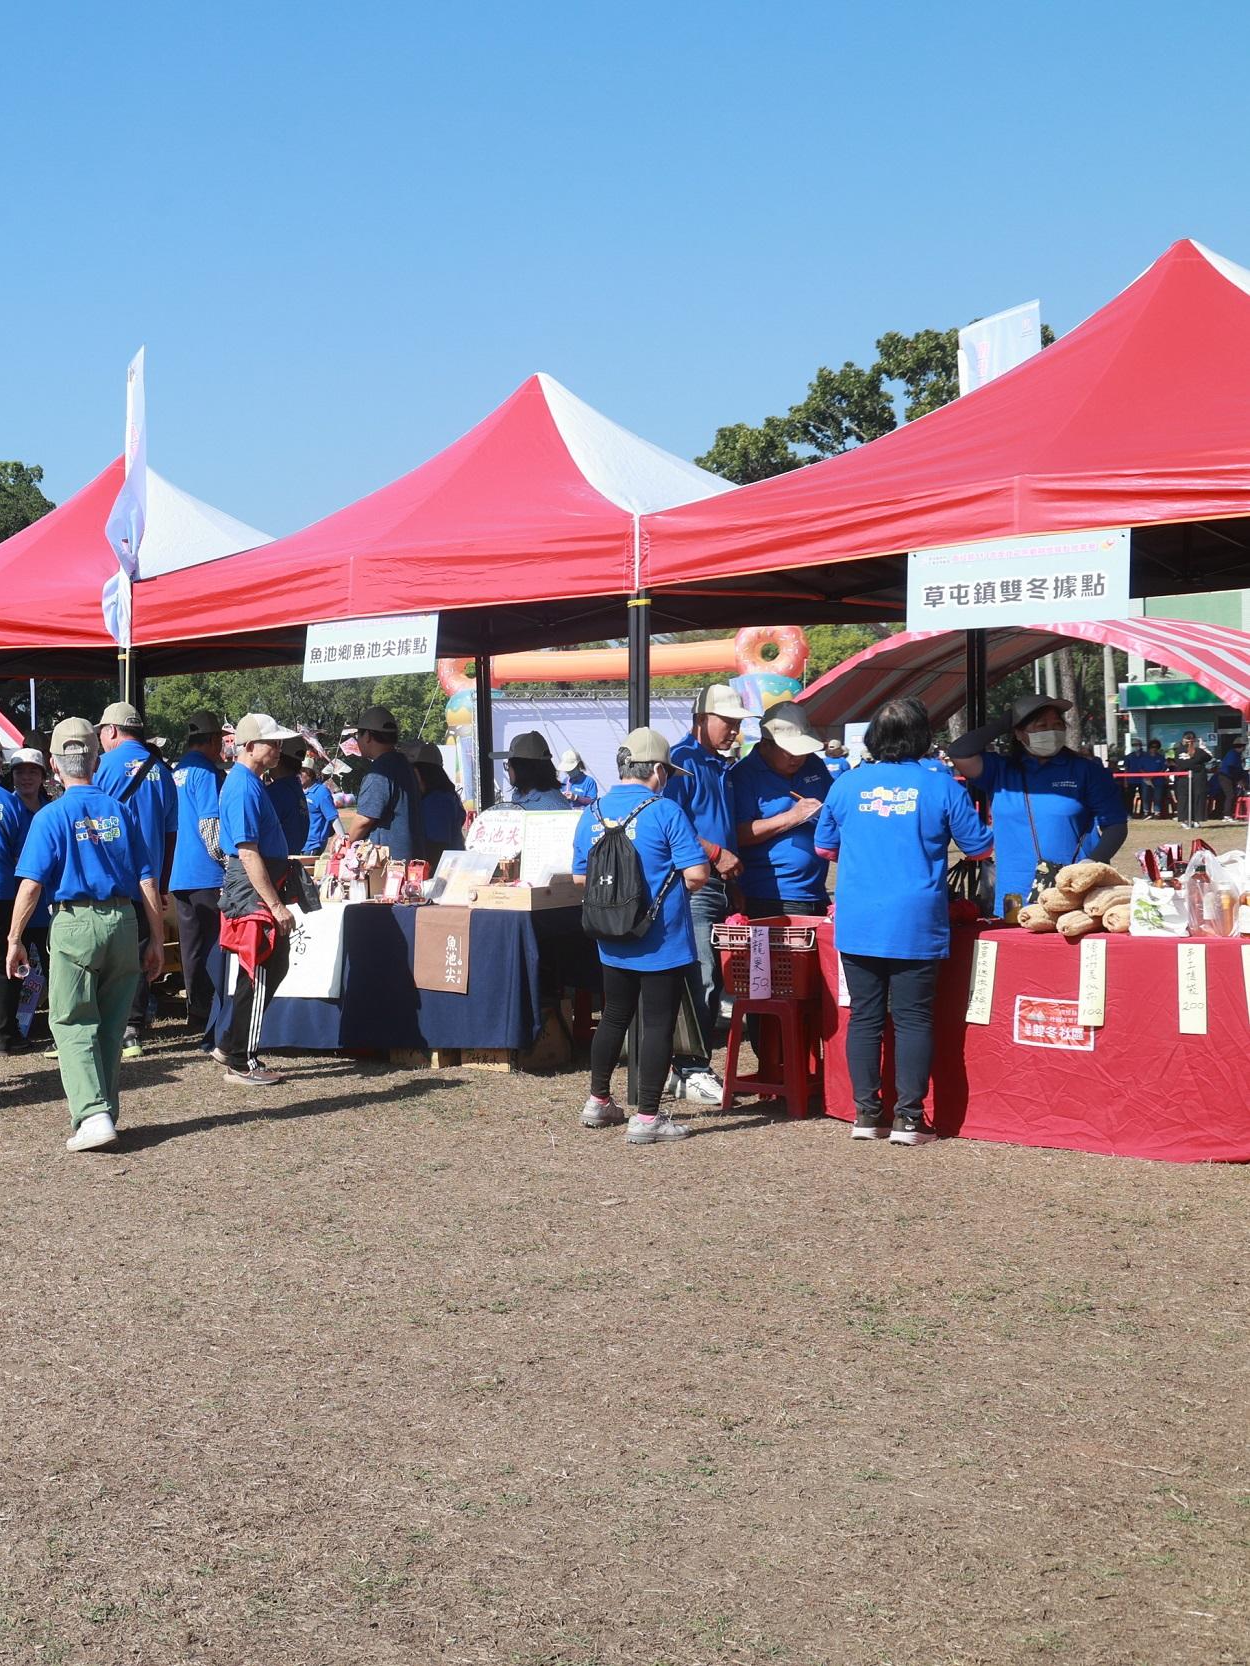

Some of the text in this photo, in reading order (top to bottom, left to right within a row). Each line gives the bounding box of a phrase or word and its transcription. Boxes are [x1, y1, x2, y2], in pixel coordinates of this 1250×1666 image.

[923, 573, 1106, 608] 草屯鎮雙冬據點
[310, 637, 428, 664] 魚池鄉魚池尖據點
[471, 825, 520, 845] 魚池尖
[445, 934, 458, 983] 魚池尖
[1182, 1002, 1205, 1010] 200
